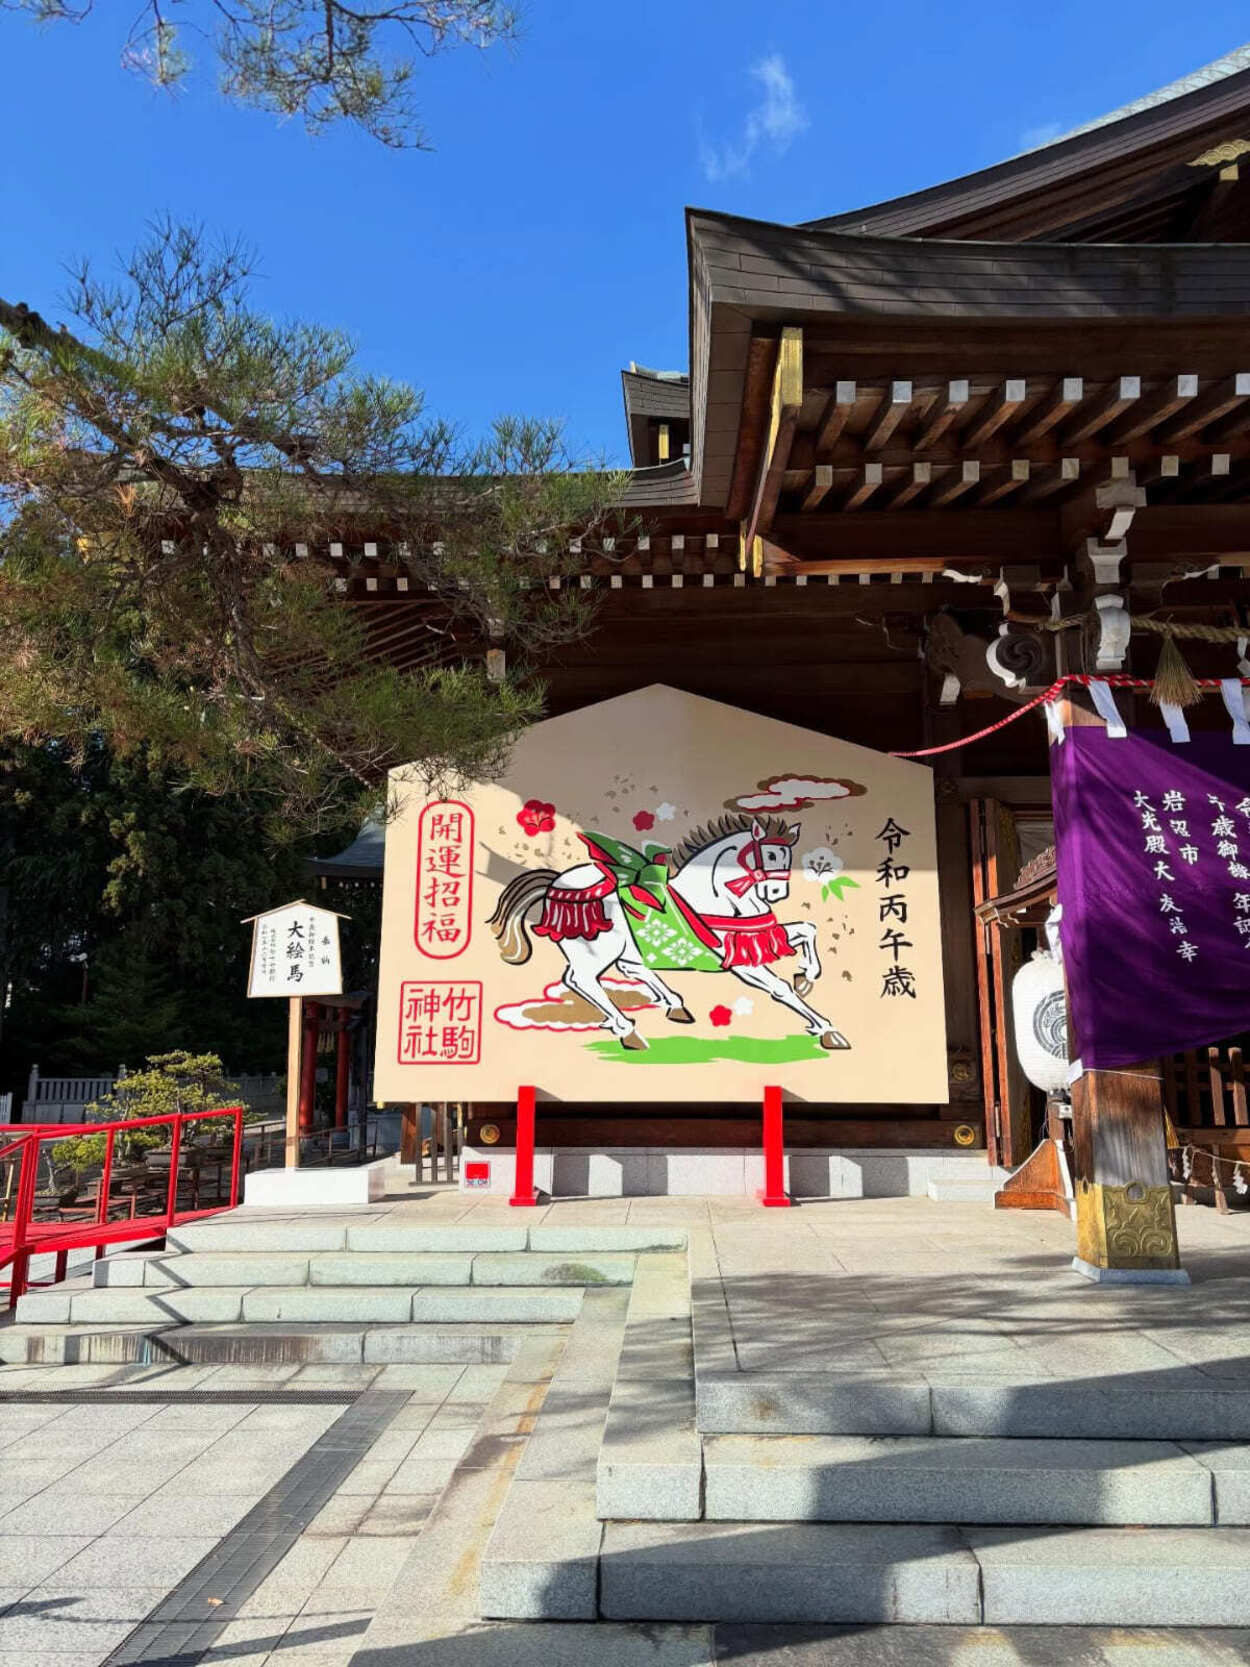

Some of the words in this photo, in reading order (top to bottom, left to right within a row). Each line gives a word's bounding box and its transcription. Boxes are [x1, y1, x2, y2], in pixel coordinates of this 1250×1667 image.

[421, 812, 467, 943] 開運招福
[875, 817, 917, 1000] 令和丙午歳
[286, 920, 305, 982] 大絵馬
